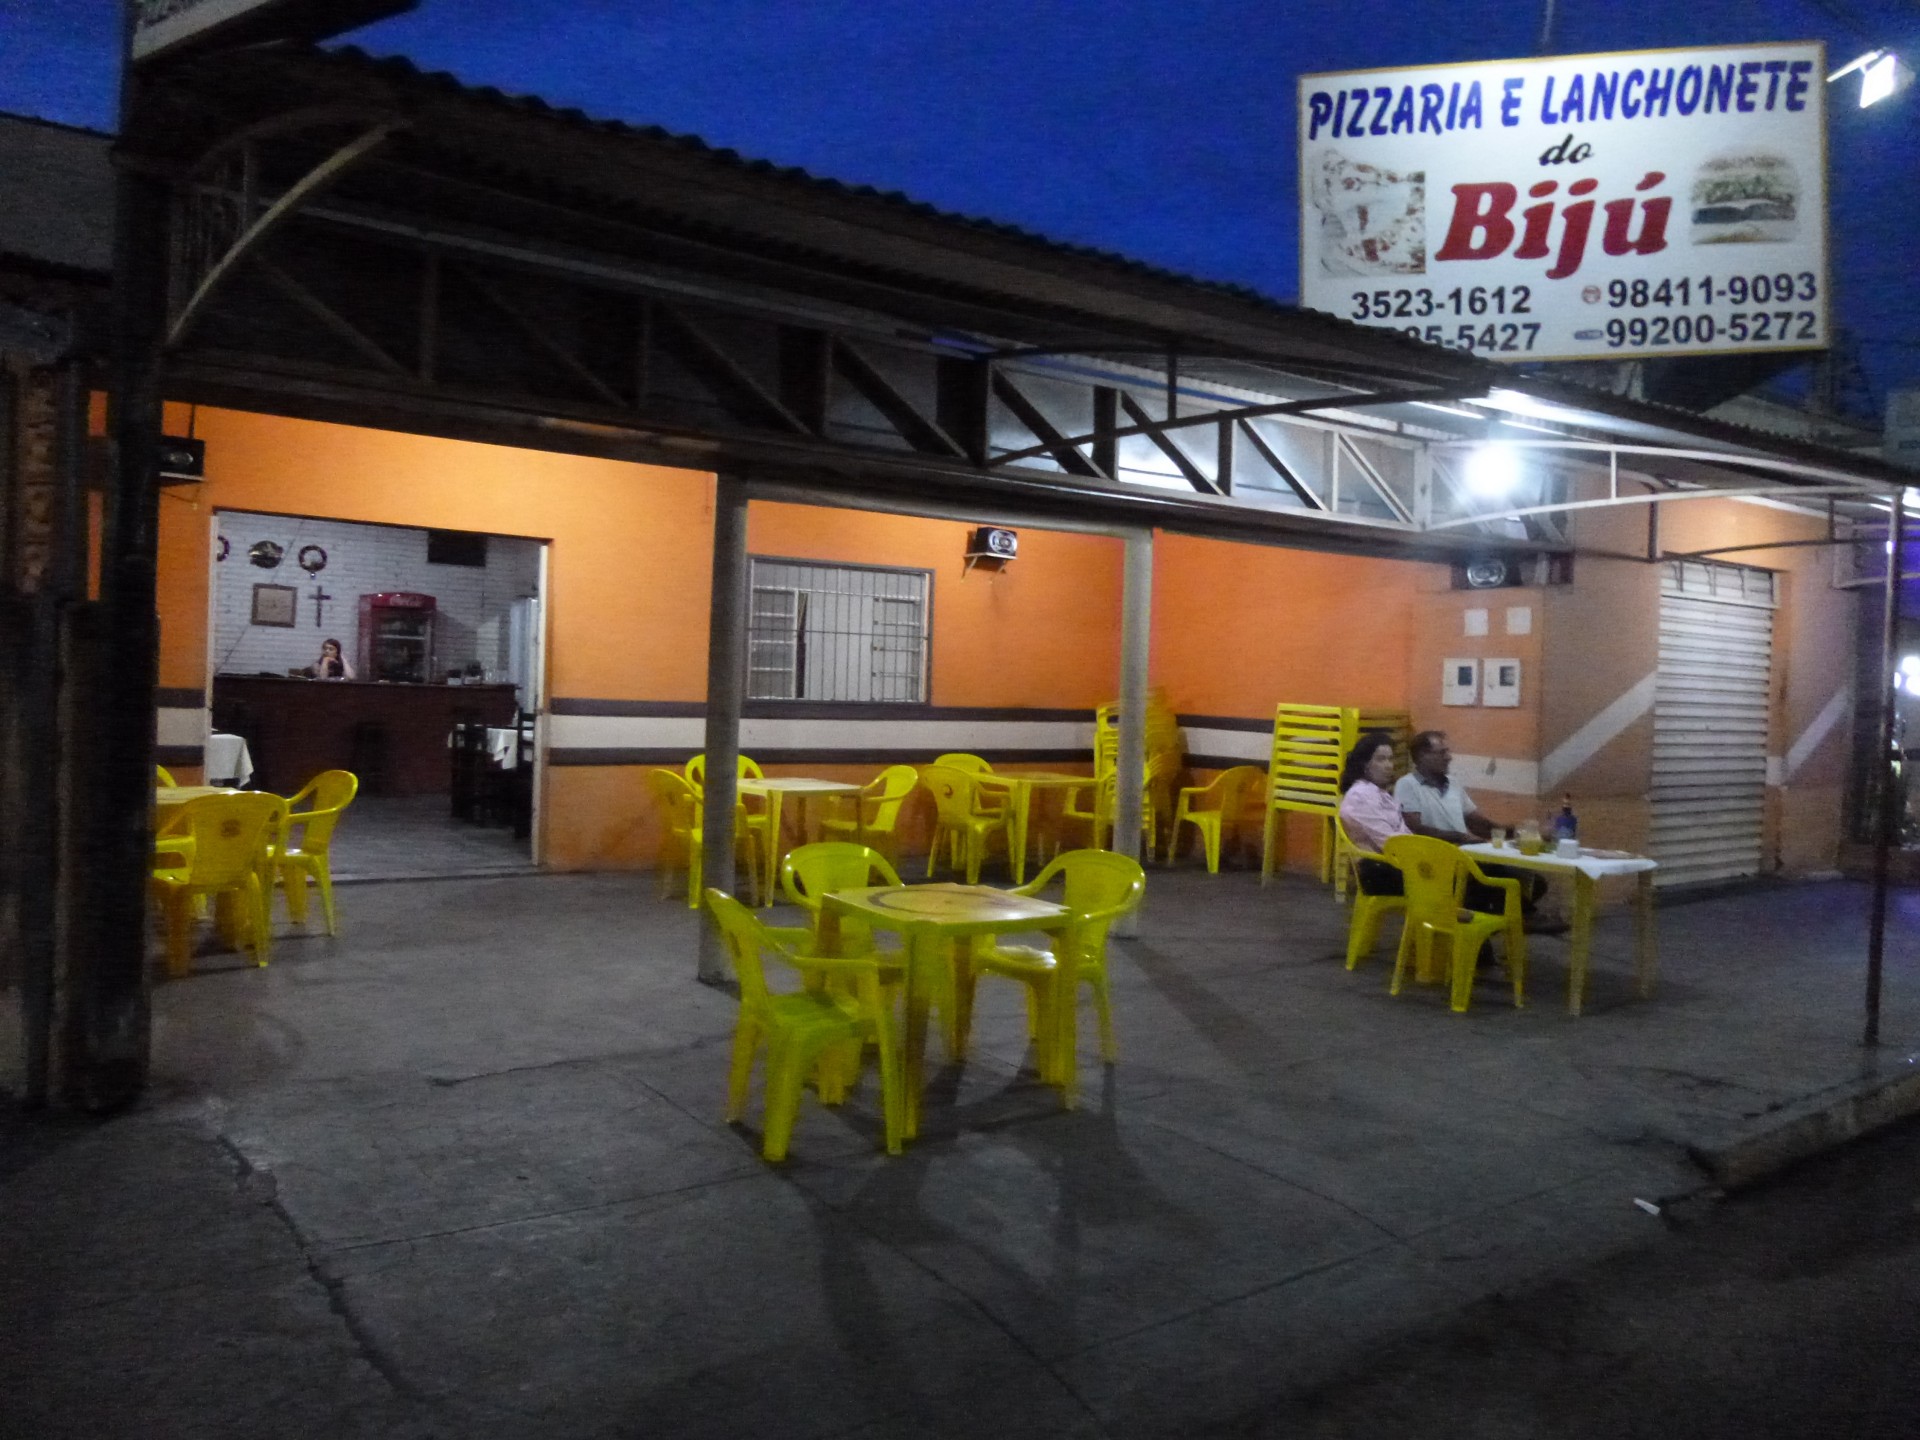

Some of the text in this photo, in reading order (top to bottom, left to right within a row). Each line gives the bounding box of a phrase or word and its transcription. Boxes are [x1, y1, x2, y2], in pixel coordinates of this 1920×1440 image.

[1308, 60, 1813, 141] PIZZARIA E LANCHONETE
[1538, 132, 1594, 166] do
[1434, 171, 1673, 280] Bijú
[1351, 285, 1531, 320] 3523-1612
[1607, 272, 1817, 308] 98411-9093
[1605, 310, 1817, 348] 99200-5272
